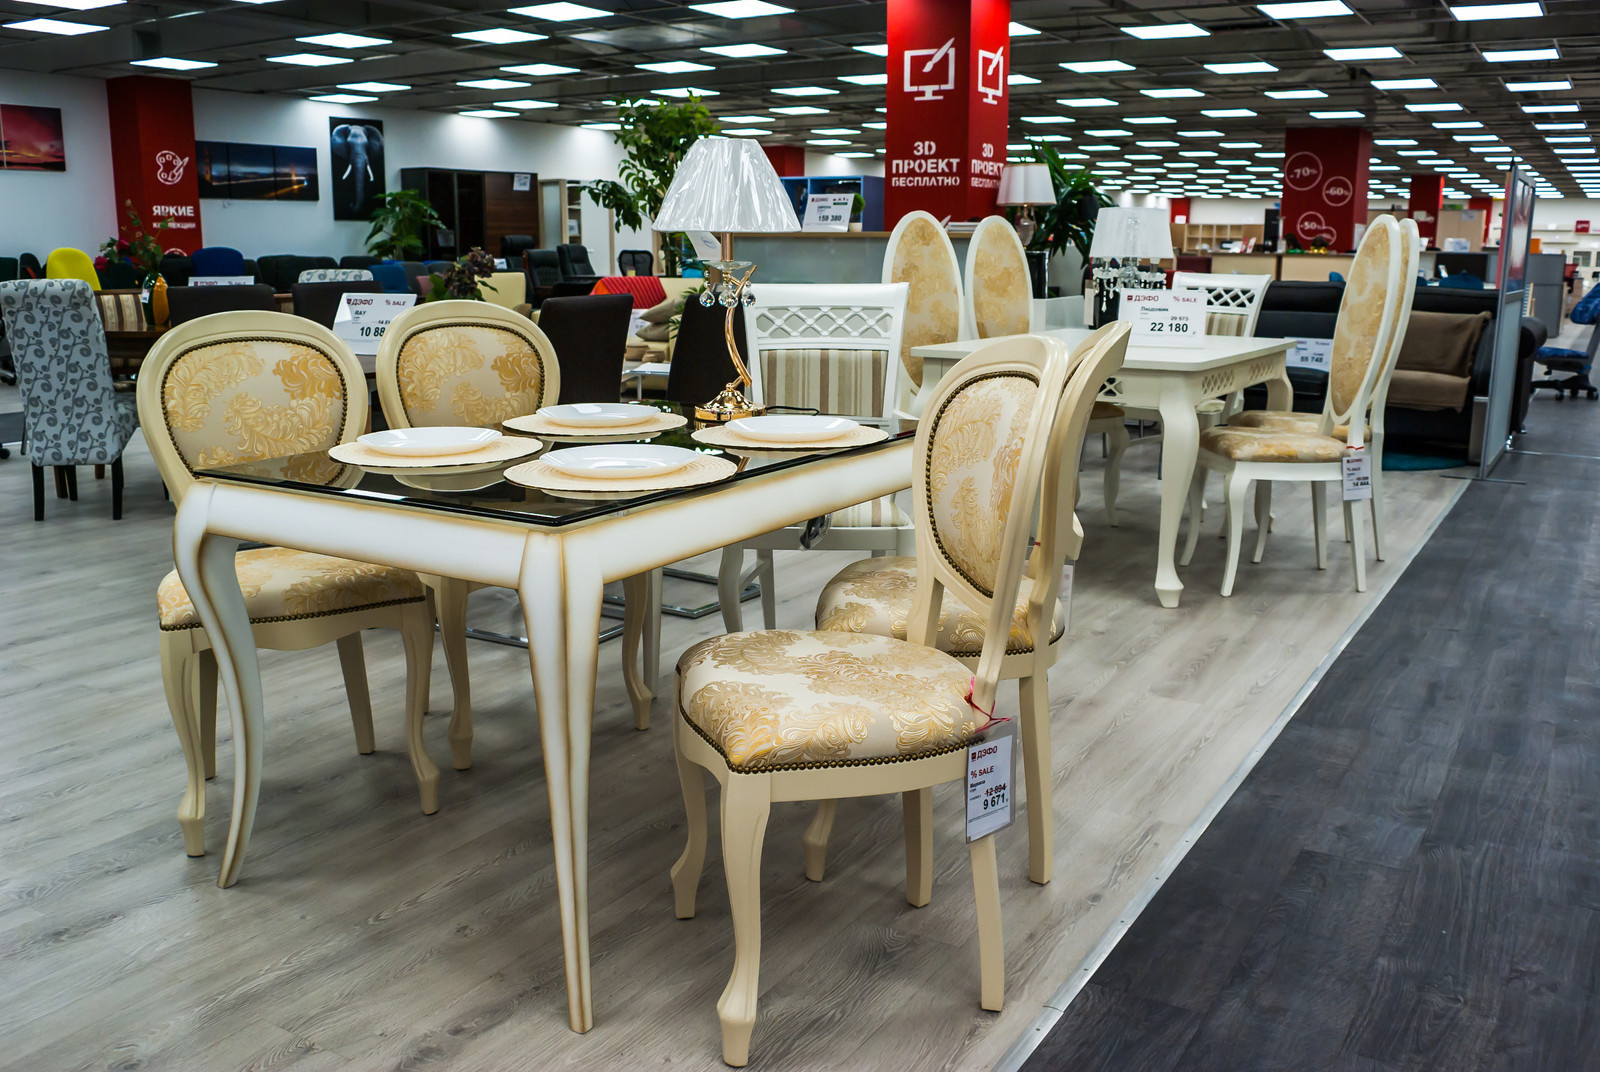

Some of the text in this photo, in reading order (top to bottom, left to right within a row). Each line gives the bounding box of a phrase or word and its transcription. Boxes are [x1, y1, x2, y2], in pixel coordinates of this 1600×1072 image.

[913, 141, 936, 155] 3D
[982, 143, 994, 158] 3D
[892, 158, 960, 173] ПРОЕКТ
[971, 159, 1004, 176] ПРОЕКТ
[892, 176, 960, 187] БЕСПЛАТНО
[152, 205, 194, 216] ЯРКИЕ
[351, 298, 374, 306] ДЭФО
[1134, 294, 1159, 302] ДЭФО
[360, 326, 371, 337] 10
[1150, 322, 1188, 333] 22 180
[977, 745, 998, 760] ДЭФО
[978, 765, 995, 777] SALE
[983, 799, 989, 810] 9
[990, 793, 1005, 808] 671
